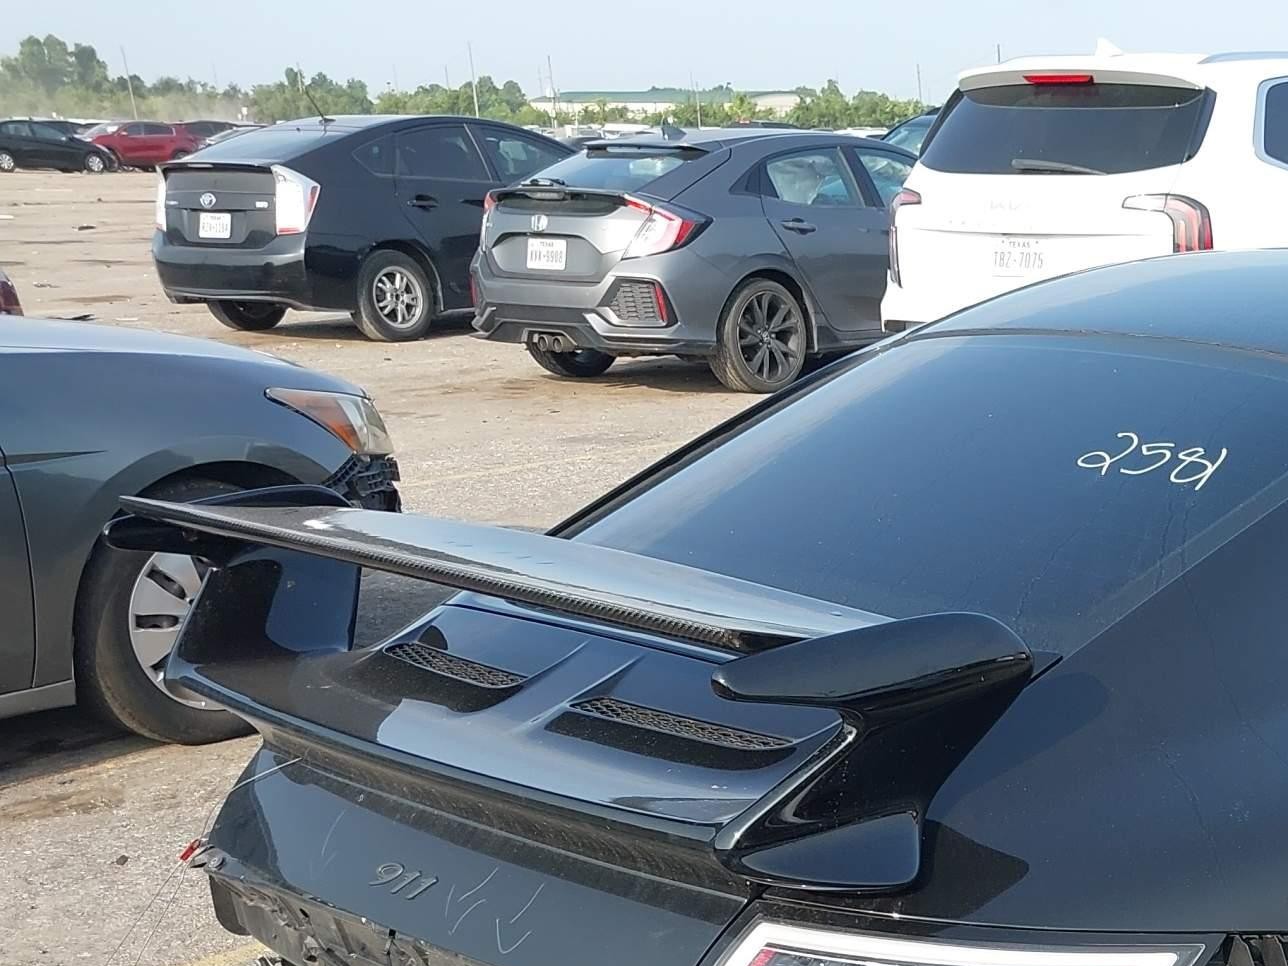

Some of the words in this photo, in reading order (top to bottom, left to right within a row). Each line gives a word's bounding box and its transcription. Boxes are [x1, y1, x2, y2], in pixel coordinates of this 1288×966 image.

[1008, 241, 1031, 249] TEXAS
[1077, 432, 1228, 491] 2581
[368, 862, 439, 900] 911
